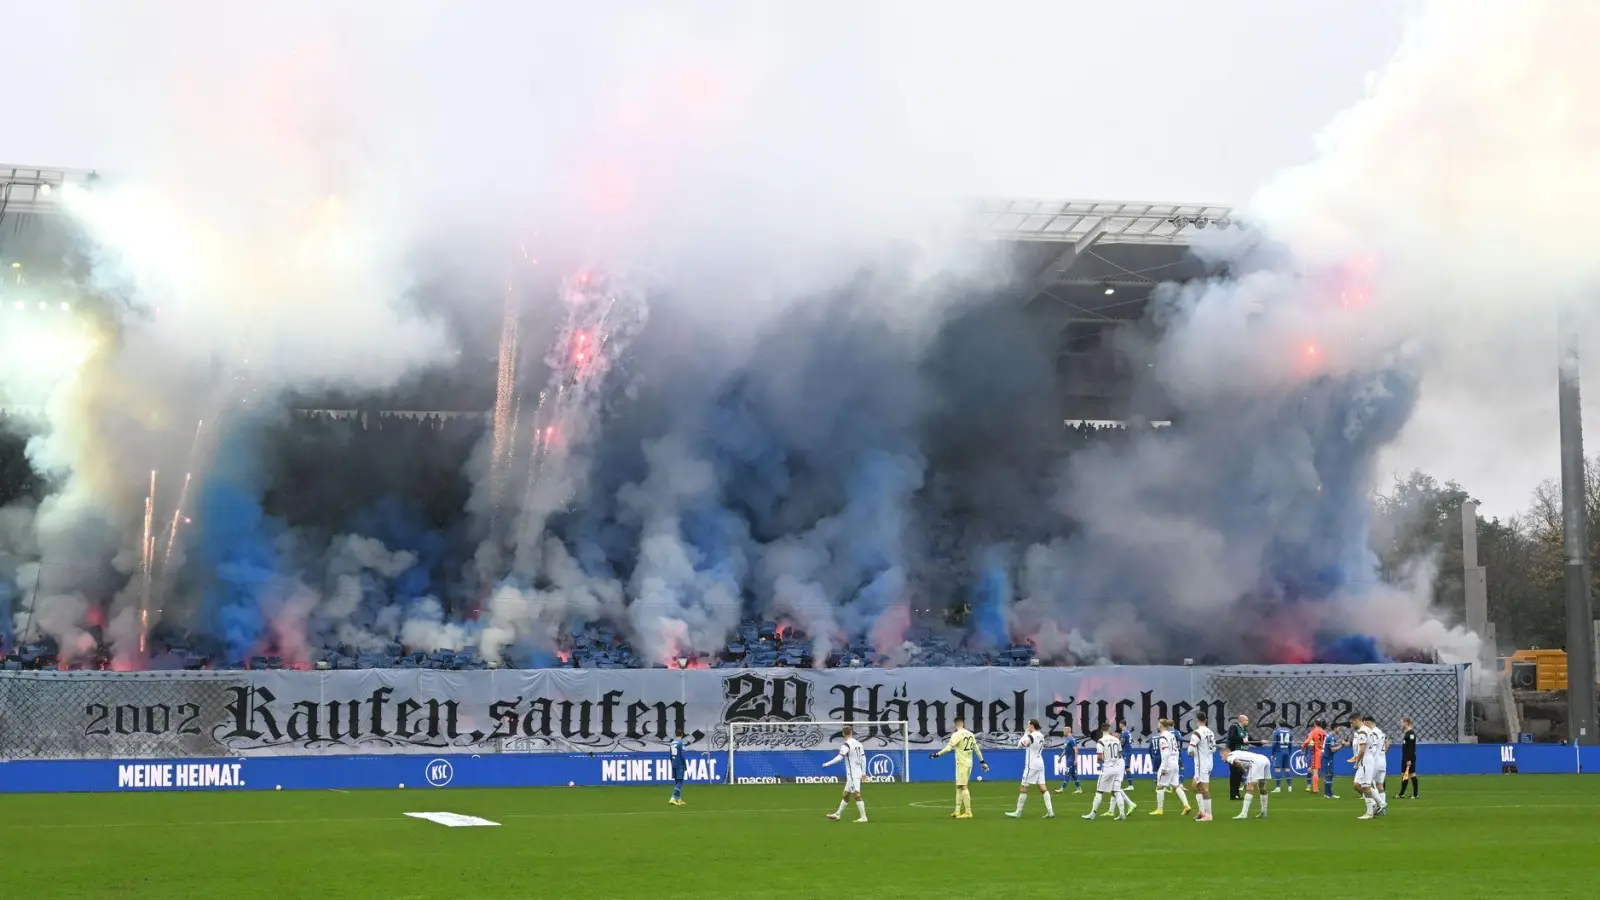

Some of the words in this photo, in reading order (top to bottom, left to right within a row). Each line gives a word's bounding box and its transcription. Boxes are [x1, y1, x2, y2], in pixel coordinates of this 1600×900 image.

[723, 672, 813, 721] 20
[85, 702, 201, 735] 2002
[213, 682, 485, 747] Raufen,
[489, 690, 705, 746] saufen,
[829, 682, 1028, 742] Händel
[1256, 699, 1353, 729] 2022
[1279, 732, 1290, 744] 14
[1108, 742, 1118, 759] 10
[119, 764, 173, 787] MEINE
[176, 763, 246, 787] HEIMAT.
[431, 765, 448, 781] KSC
[602, 759, 653, 782] MEINE
[874, 760, 889, 775] KSC
[1054, 754, 1101, 776] MINE
[738, 776, 781, 784] macron
[796, 775, 838, 784] macron
[861, 775, 896, 784] acron
